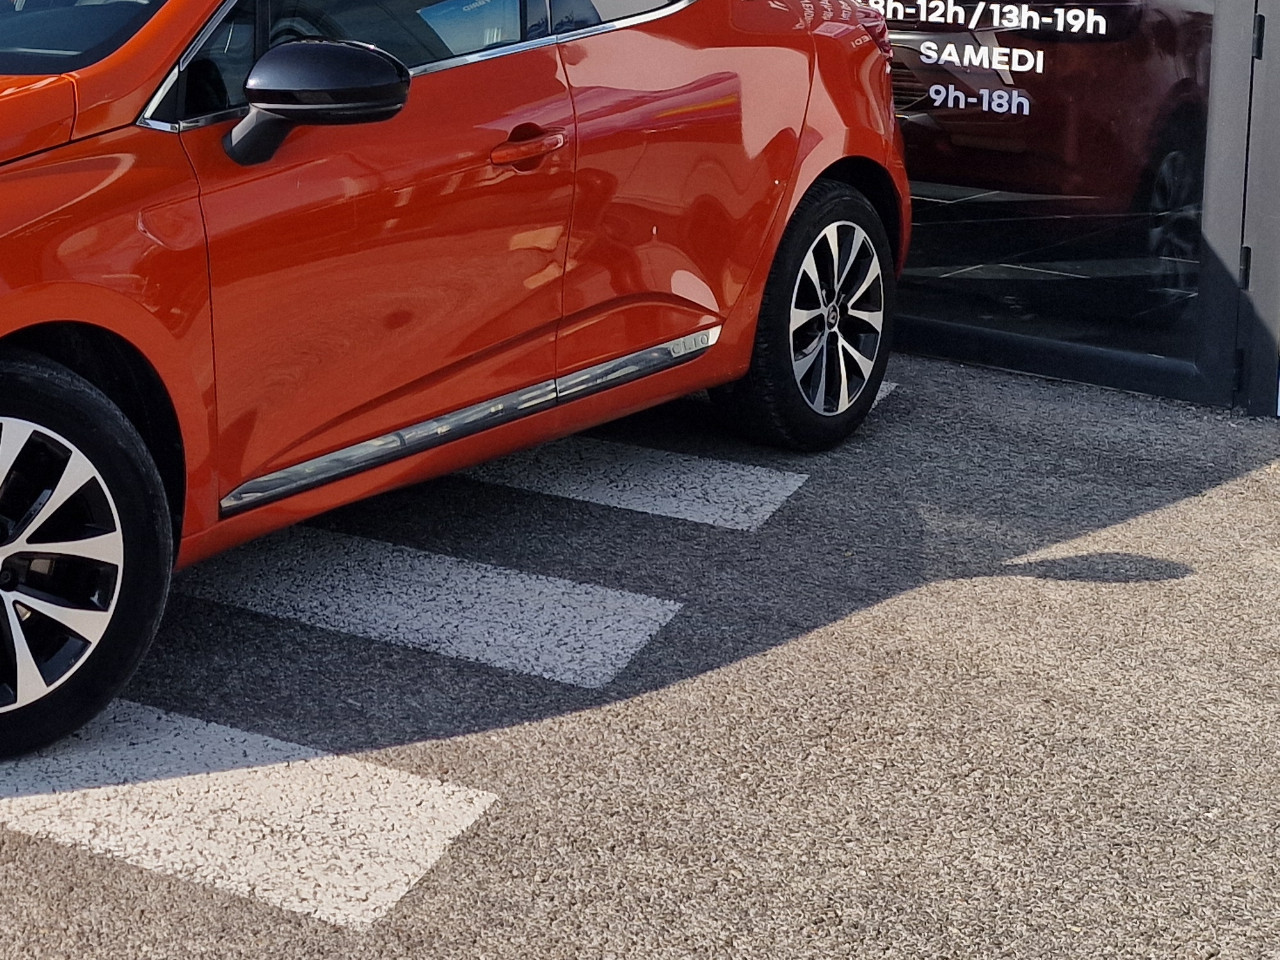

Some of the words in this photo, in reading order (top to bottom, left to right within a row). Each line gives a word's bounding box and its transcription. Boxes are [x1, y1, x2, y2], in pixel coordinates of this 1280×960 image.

[919, 40, 1044, 74] SAMEDI
[928, 84, 1030, 116] 9h-18h
[672, 334, 708, 354] CLIO
